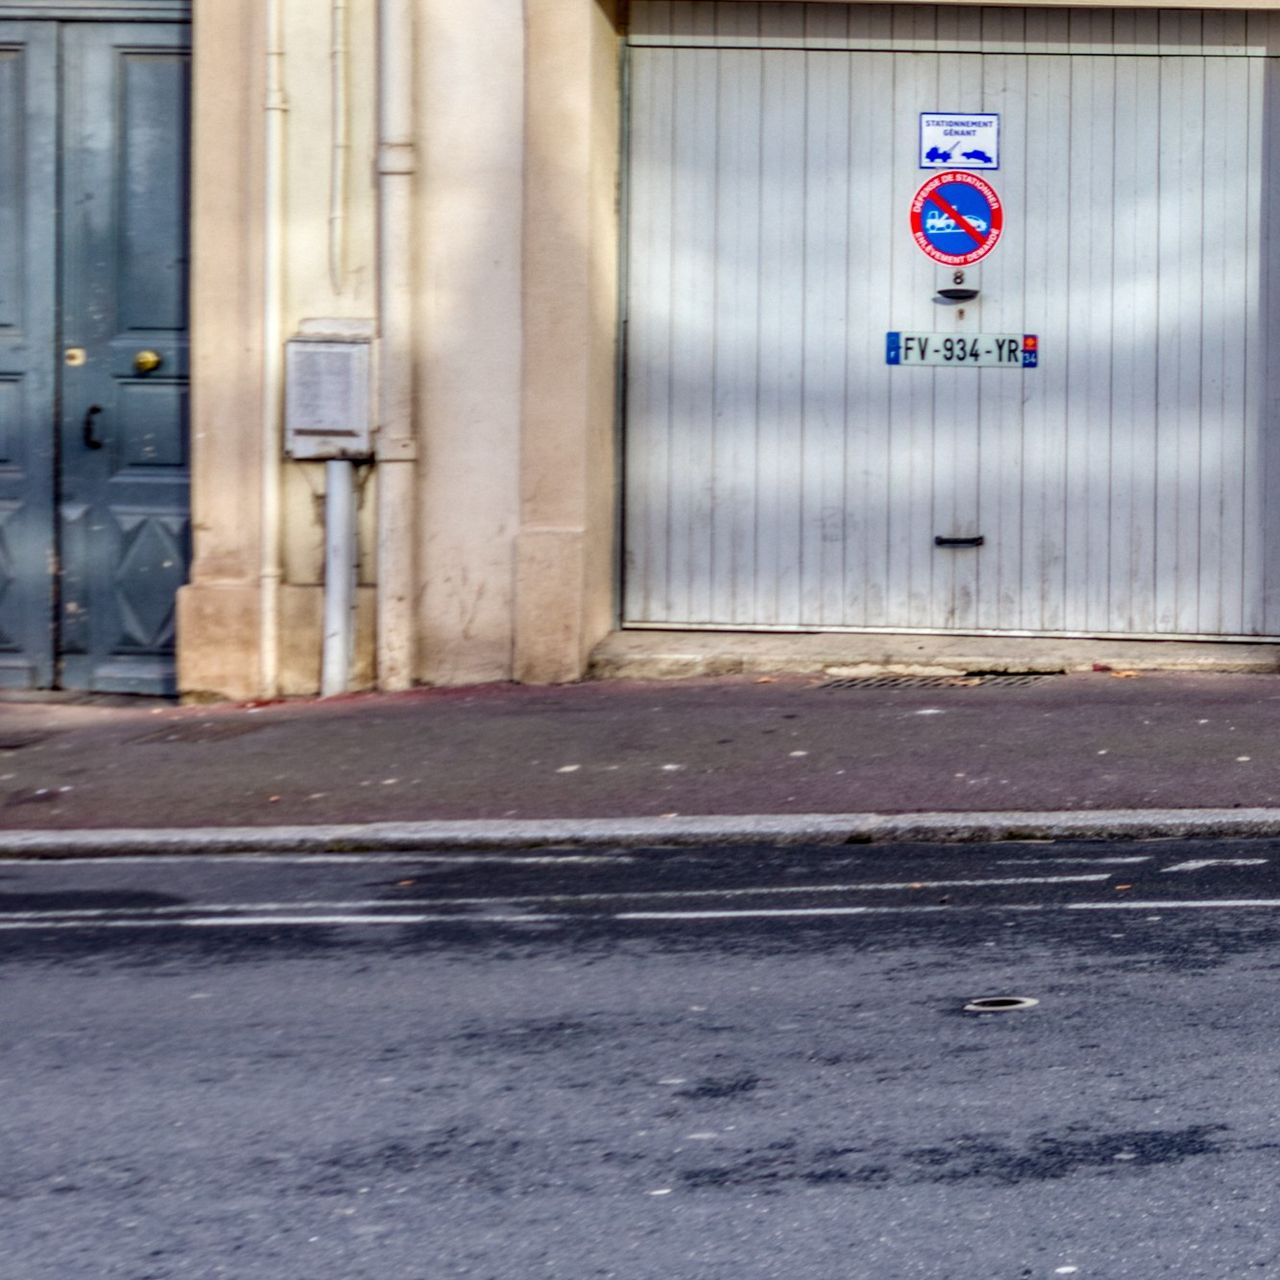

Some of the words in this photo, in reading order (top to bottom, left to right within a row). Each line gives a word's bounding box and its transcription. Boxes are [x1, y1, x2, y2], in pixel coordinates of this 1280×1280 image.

[925, 120, 993, 128] STATIONNEMENT
[912, 178, 941, 213] DÉFENSE
[940, 173, 954, 183] DE
[955, 173, 1000, 210] STATIONNER
[903, 336, 1019, 363] FV-934-YR
[1023, 352, 1036, 363] 34
